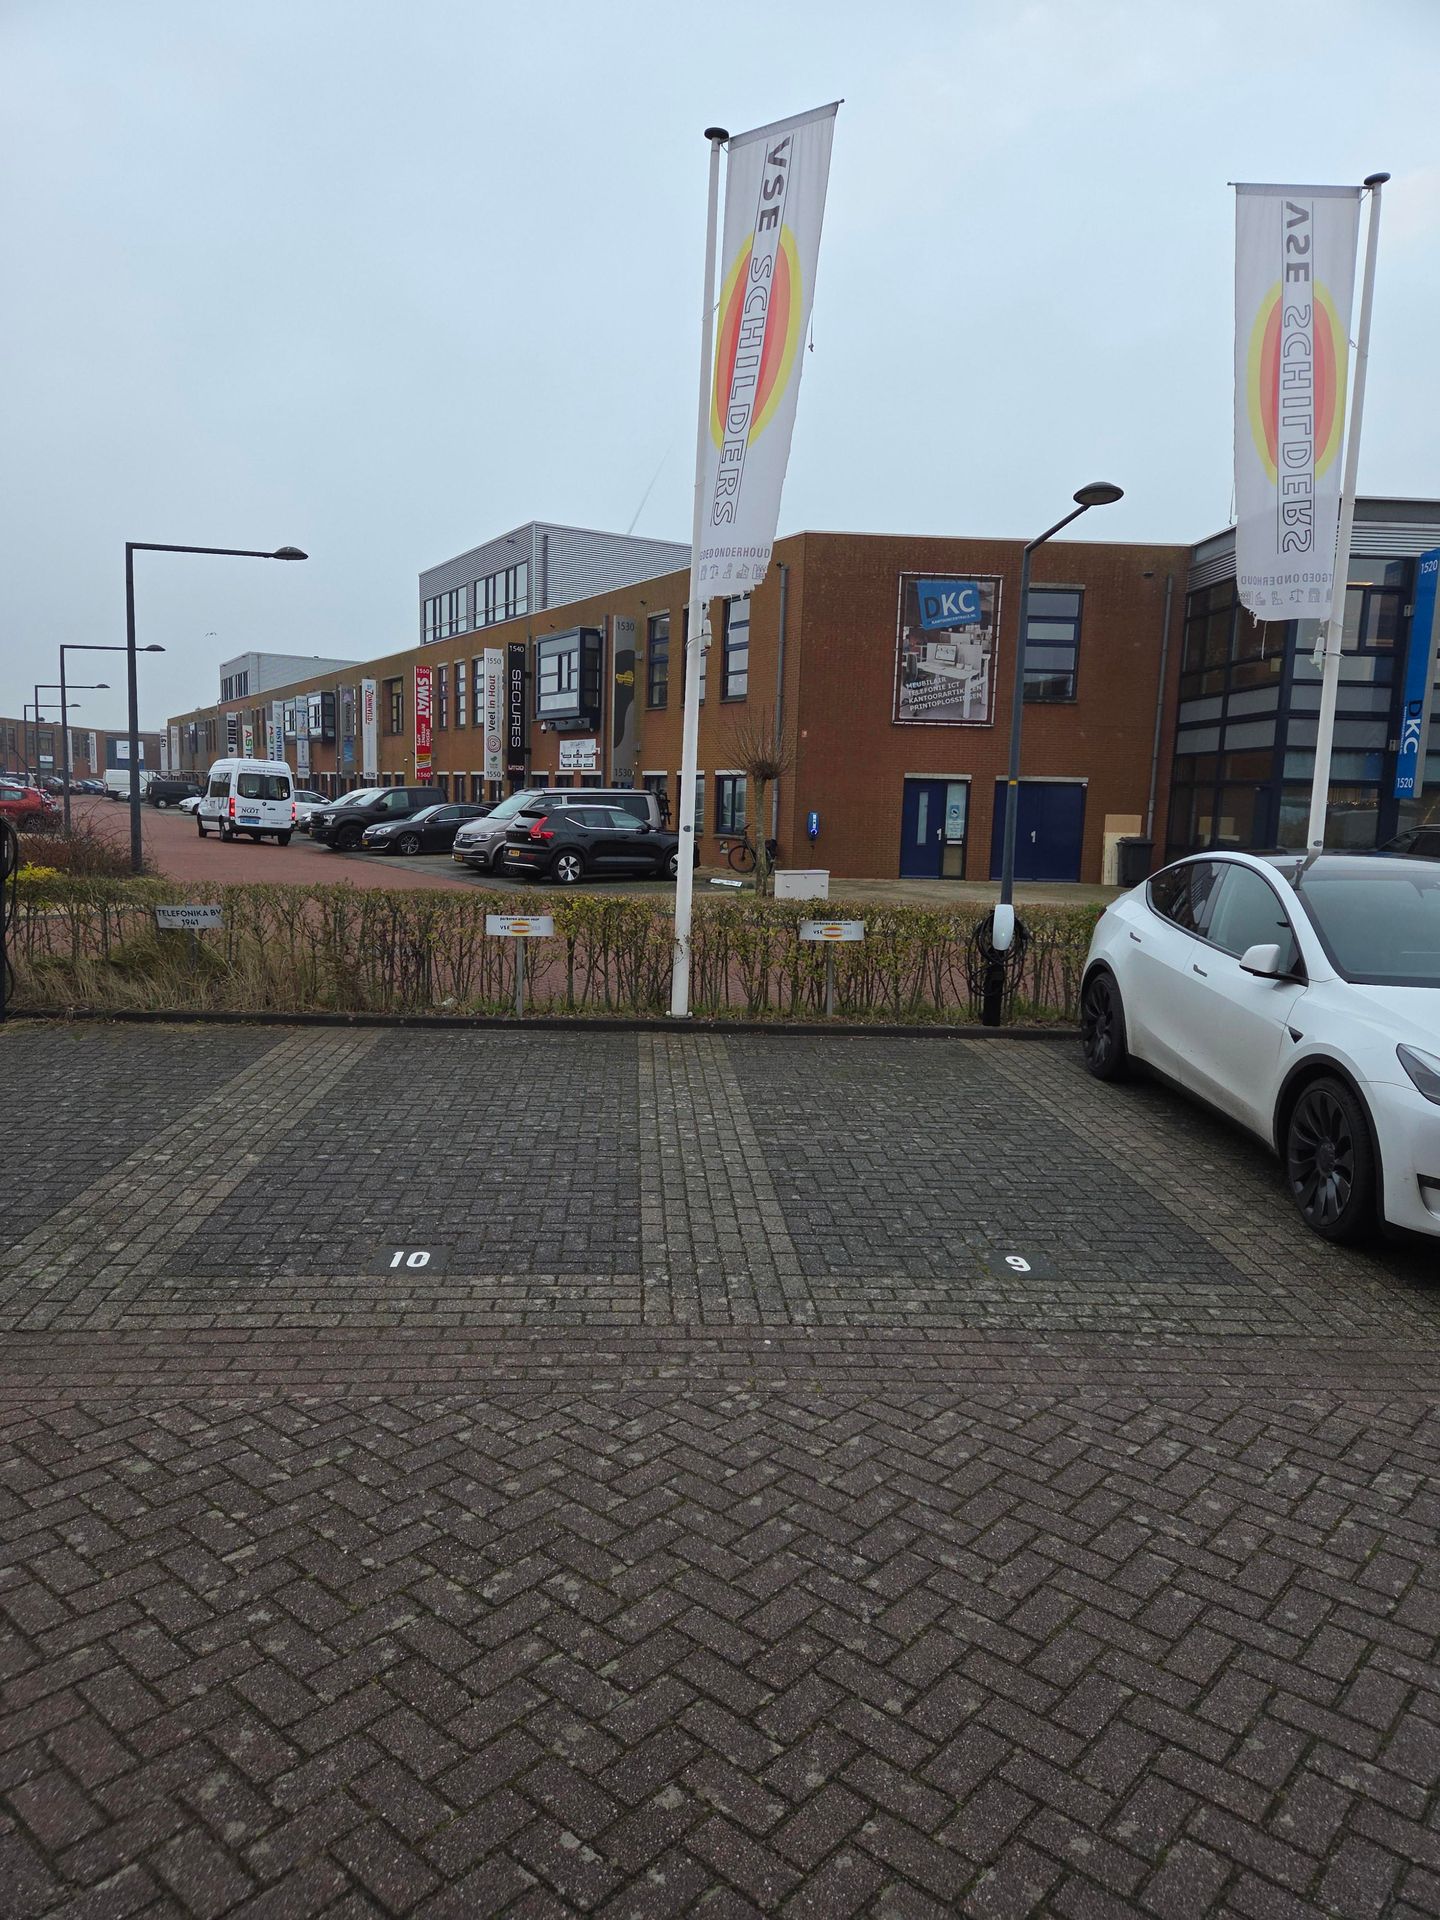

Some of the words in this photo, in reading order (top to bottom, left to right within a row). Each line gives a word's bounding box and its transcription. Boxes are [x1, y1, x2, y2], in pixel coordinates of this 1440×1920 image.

[758, 136, 791, 233] VSE
[713, 255, 773, 527] SCHILDERS
[1421, 559, 1438, 574] 1520
[924, 589, 976, 619] DKC
[617, 621, 635, 632] 1530
[509, 645, 524, 653] 1540
[486, 657, 501, 665] 1550
[488, 674, 496, 697] Hout
[906, 677, 947, 689] MEUBILAIR
[908, 684, 946, 697] TELEFONIE
[948, 681, 960, 690] ICT
[417, 677, 430, 718] SWAT
[488, 700, 496, 709] in
[511, 669, 521, 747] SECURES
[488, 711, 496, 732] Veel
[1404, 701, 1422, 754] DKC
[486, 770, 501, 778] 1550
[614, 768, 633, 778] 1530
[1396, 777, 1414, 789] 1520
[157, 909, 208, 917] TELEFONIKA
[390, 1251, 431, 1267] 10
[1005, 1256, 1031, 1271] 9
